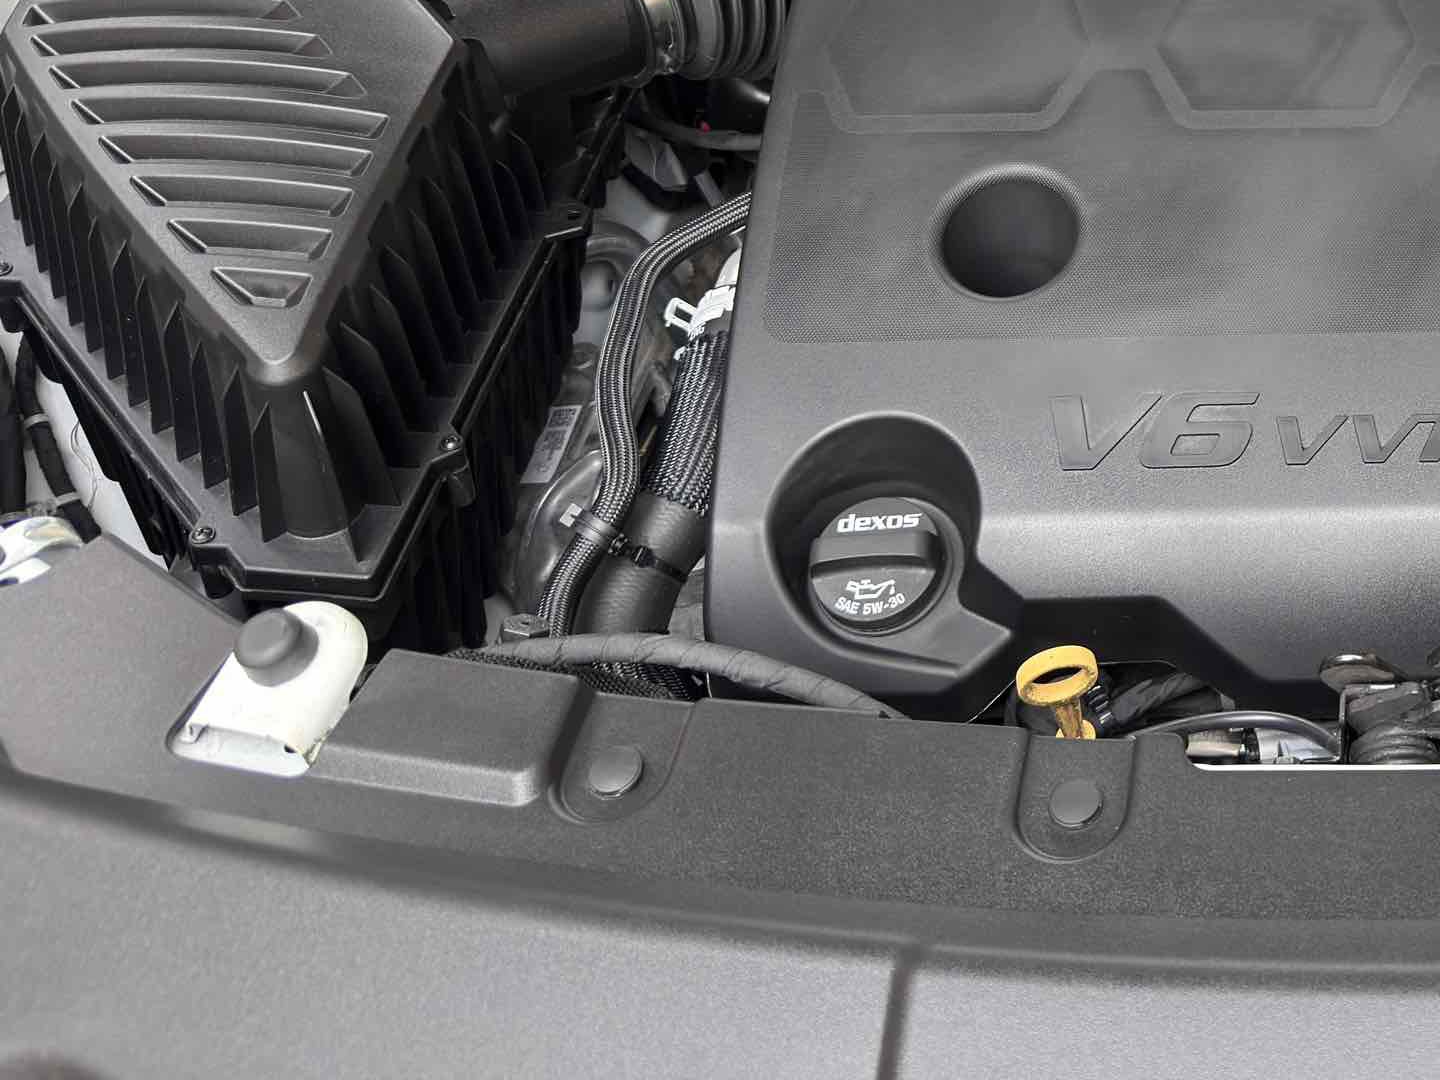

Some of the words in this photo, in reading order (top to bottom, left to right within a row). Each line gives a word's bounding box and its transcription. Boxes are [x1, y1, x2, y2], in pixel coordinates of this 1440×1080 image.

[1048, 391, 1260, 471] V6
[836, 512, 923, 533] dexos
[834, 596, 860, 615] SAE
[862, 592, 906, 615] 5W-30
